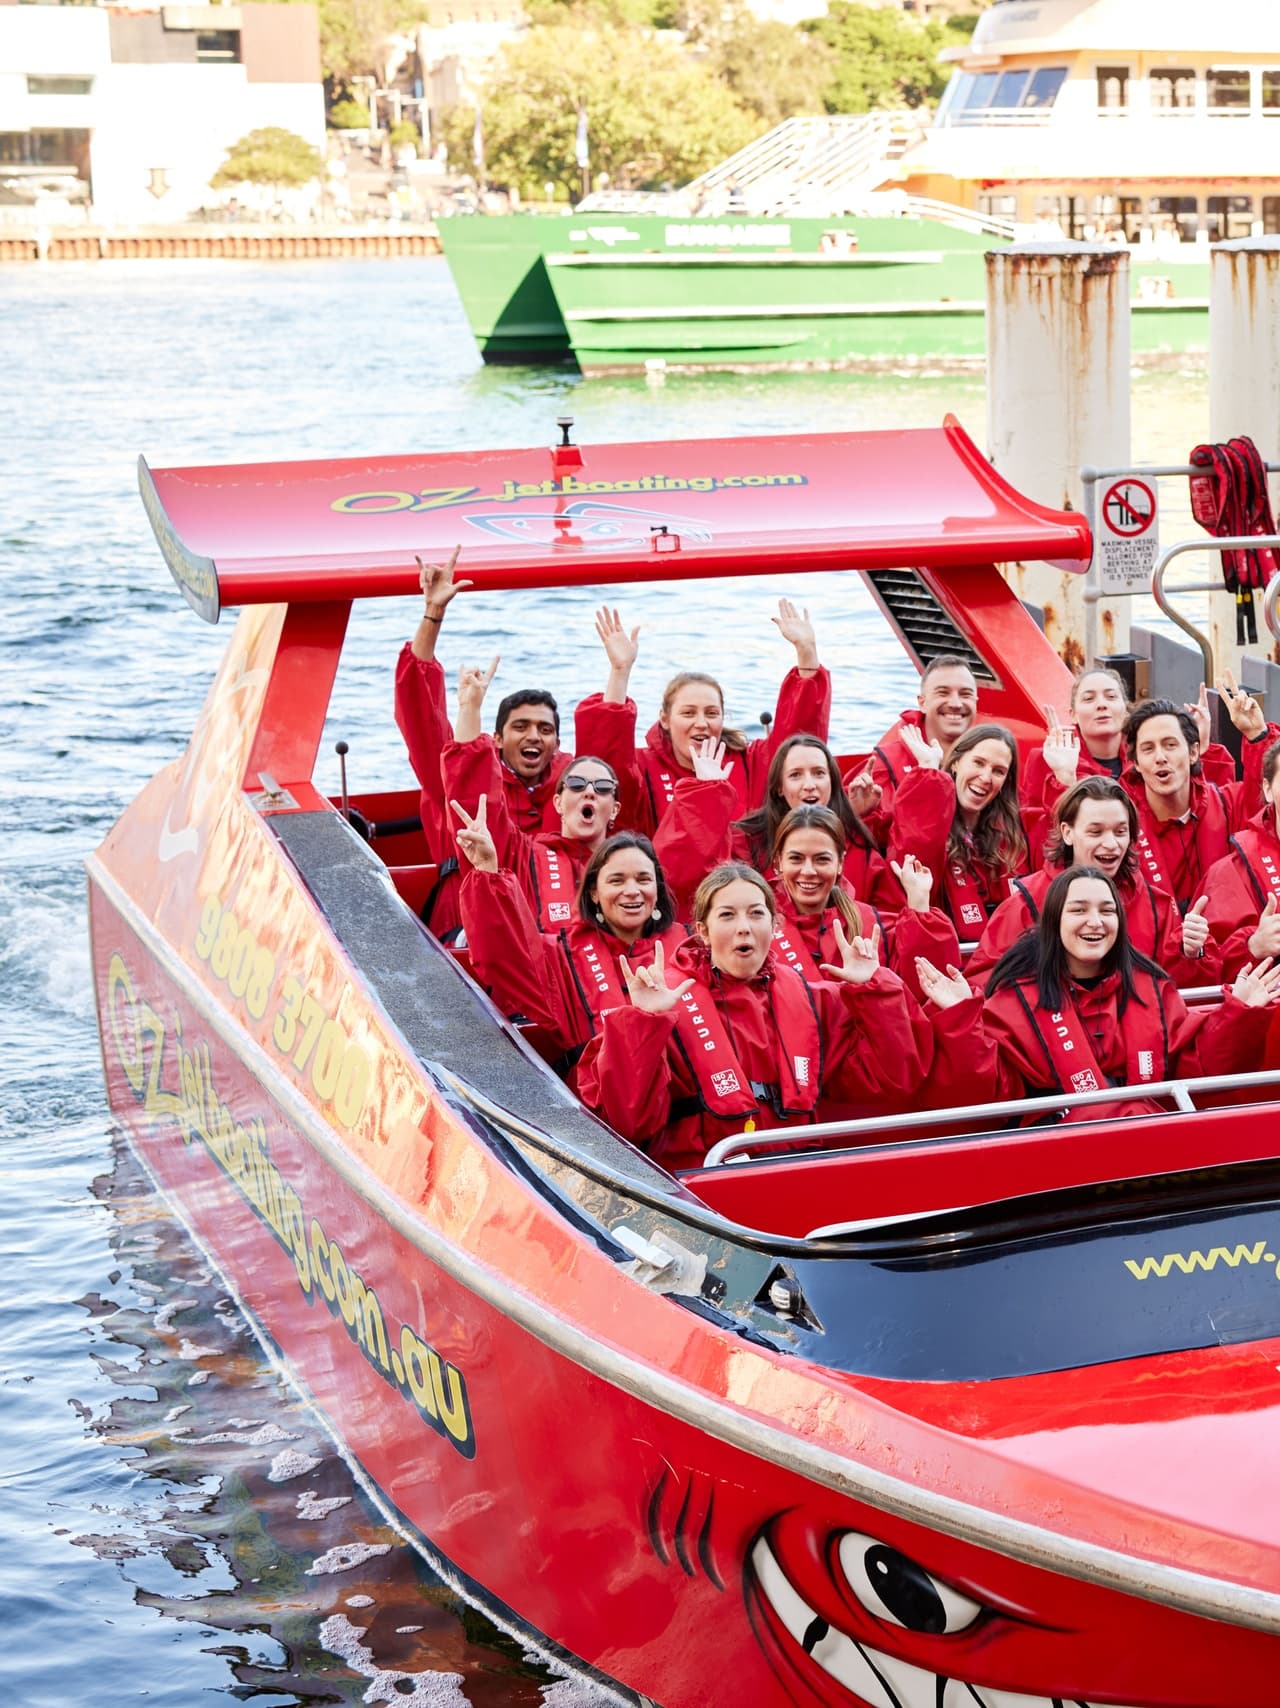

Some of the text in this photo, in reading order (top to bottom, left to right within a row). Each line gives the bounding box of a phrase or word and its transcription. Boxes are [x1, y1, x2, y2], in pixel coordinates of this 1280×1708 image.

[1105, 545, 1154, 554] DISPLACEMENT
[1107, 552, 1137, 560] ALLOWED
[1121, 565, 1153, 573] STRUCTUR
[583, 944, 609, 992] BURKE
[194, 892, 371, 1128] 9808 3700
[681, 991, 717, 1052] BURKE
[1051, 1012, 1075, 1051] BUR
